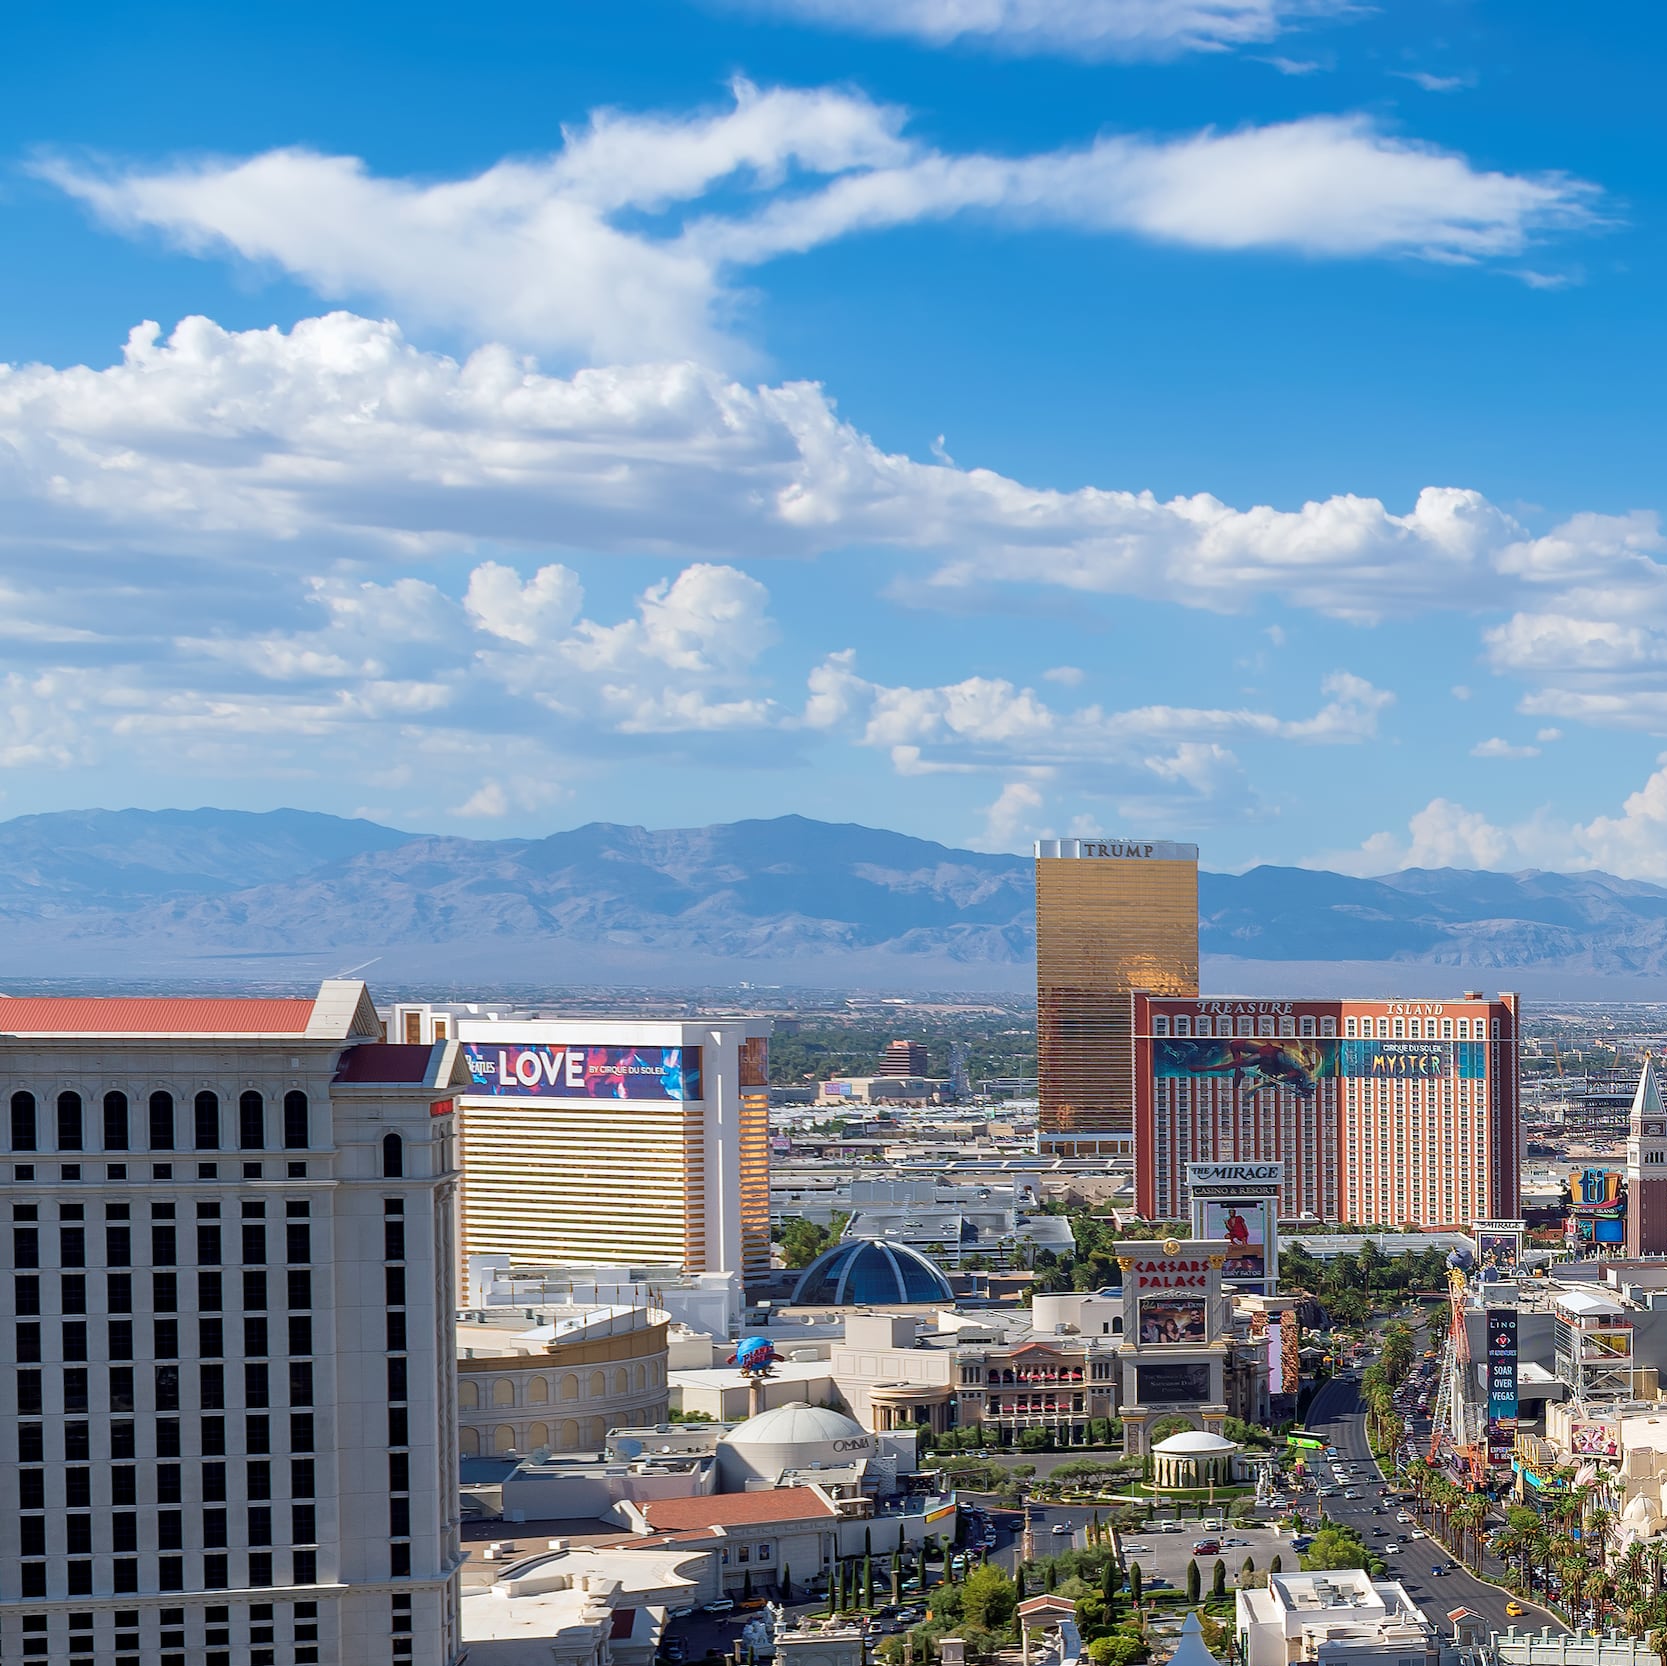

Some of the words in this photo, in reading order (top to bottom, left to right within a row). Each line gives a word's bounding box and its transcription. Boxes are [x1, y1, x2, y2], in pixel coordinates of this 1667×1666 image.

[1084, 844, 1153, 857] TRUMP
[1196, 1002, 1294, 1015] TREASURE
[1386, 1004, 1443, 1015] ISLAND
[1383, 1044, 1409, 1053] CIRQUE
[1419, 1044, 1442, 1053] SOLEIL
[499, 1051, 585, 1087] LOVE
[600, 1066, 627, 1075] CIRQUE
[628, 1067, 640, 1075] DU
[641, 1067, 666, 1075] SOLEIL
[1198, 1166, 1278, 1180] MIRAGE
[1195, 1187, 1229, 1195] CASINO
[1230, 1187, 1237, 1195] &
[1240, 1187, 1275, 1195] RESORT
[1135, 1261, 1209, 1272] CAESARS
[1139, 1276, 1206, 1288] PALACE
[1494, 1366, 1512, 1375] SOAR
[1494, 1379, 1512, 1388] OVER
[1492, 1392, 1514, 1400] VEGAS
[833, 1439, 869, 1452] OMNIA
